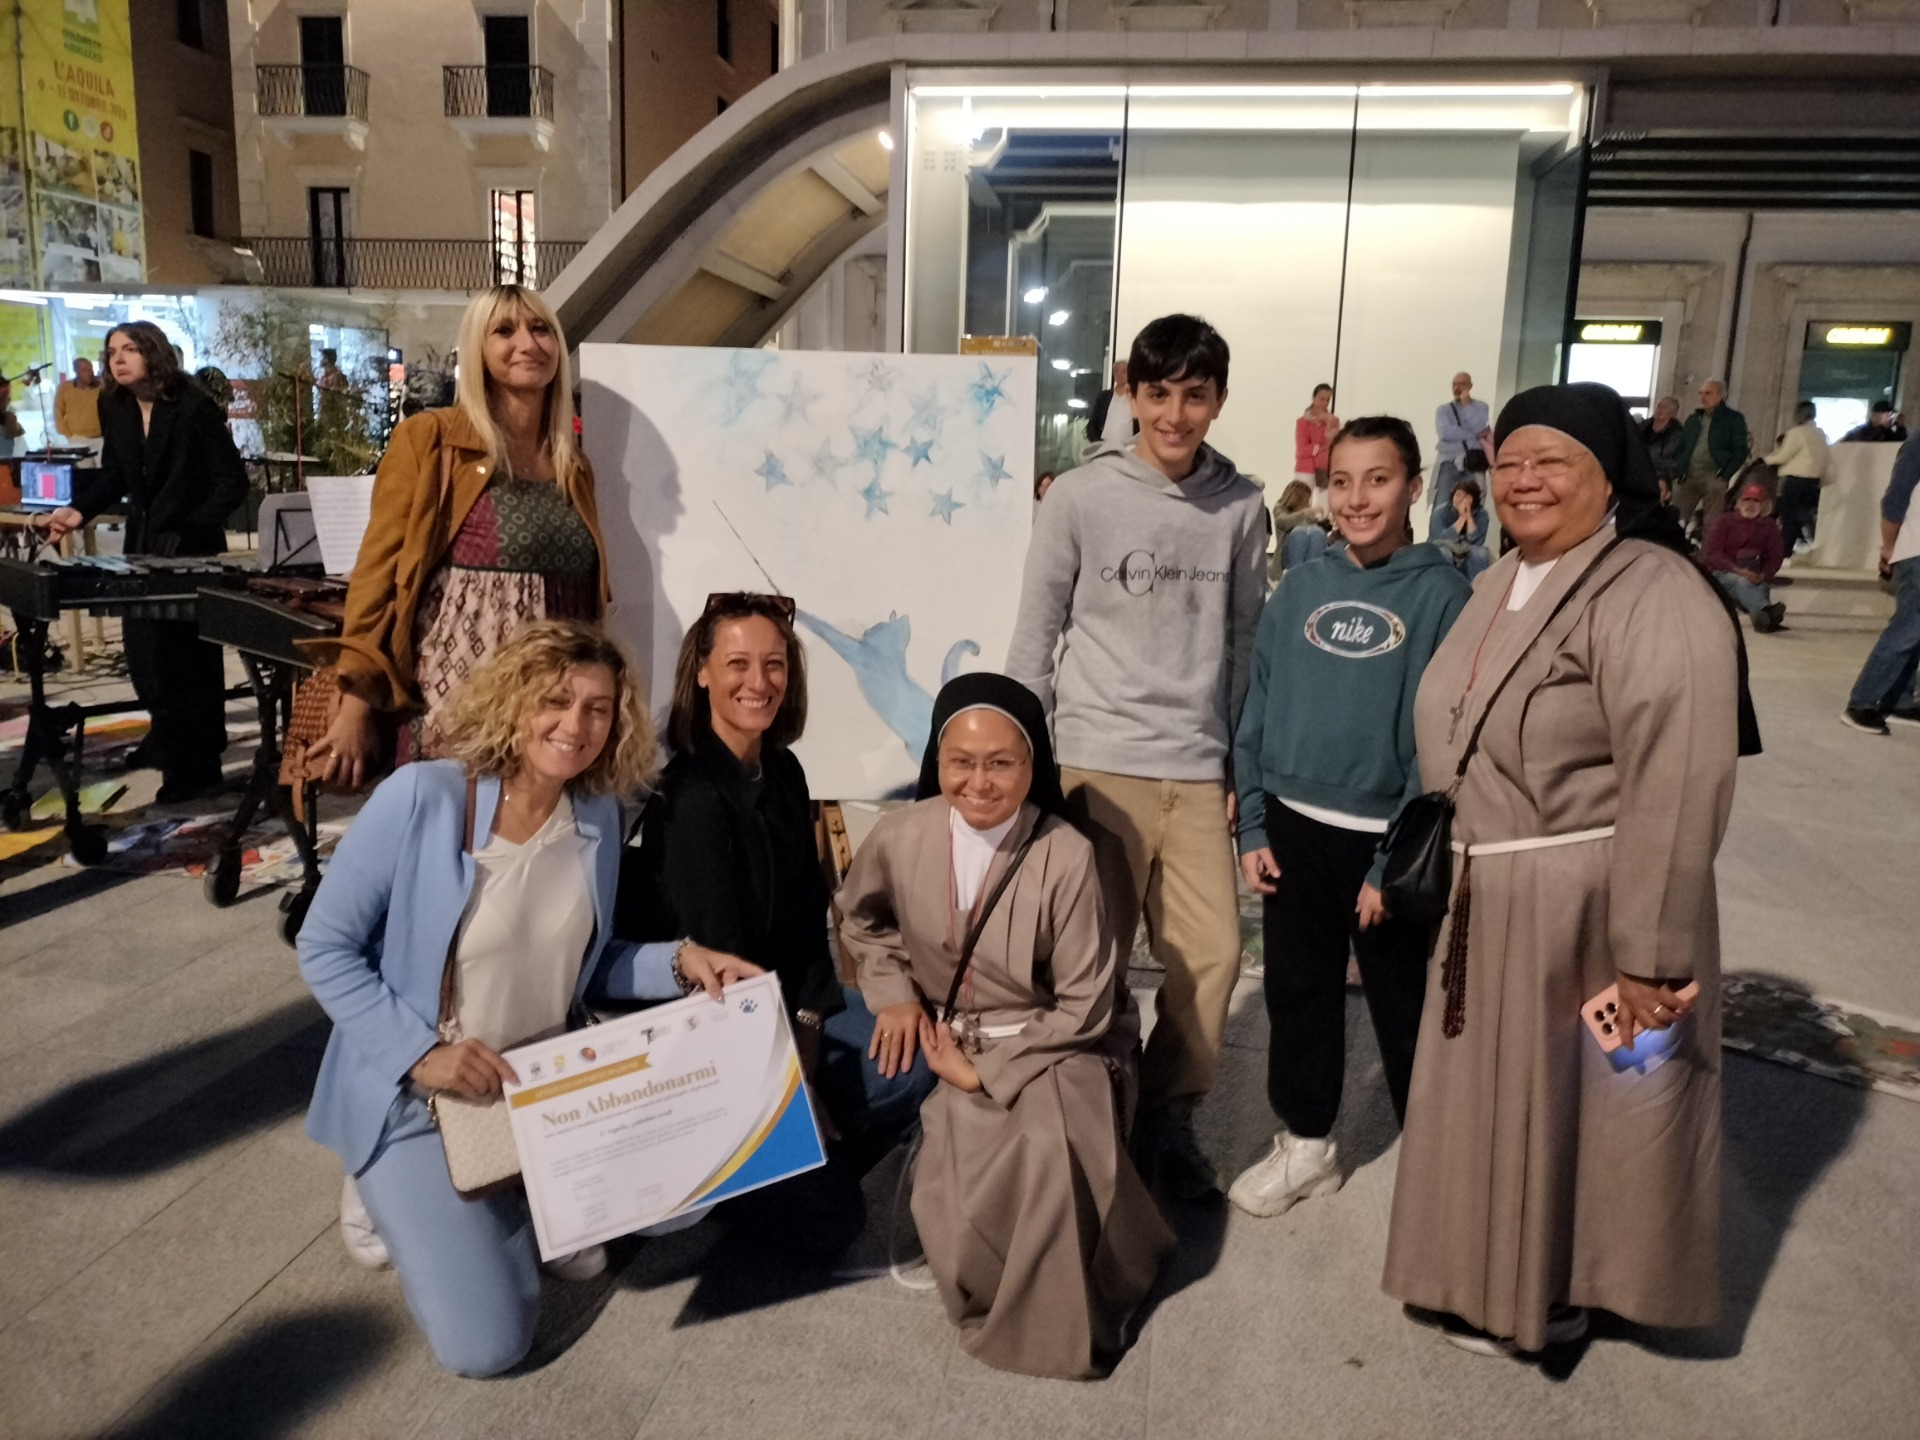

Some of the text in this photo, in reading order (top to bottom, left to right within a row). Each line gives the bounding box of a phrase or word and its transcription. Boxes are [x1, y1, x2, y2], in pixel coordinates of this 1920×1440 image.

[54, 59, 116, 98] L'AQUILA
[1101, 564, 1150, 583] Calvin
[1154, 563, 1187, 581] Klein
[1331, 617, 1374, 644] nike
[541, 1106, 582, 1130] Non
[585, 1059, 719, 1116] Abbandonarmi
